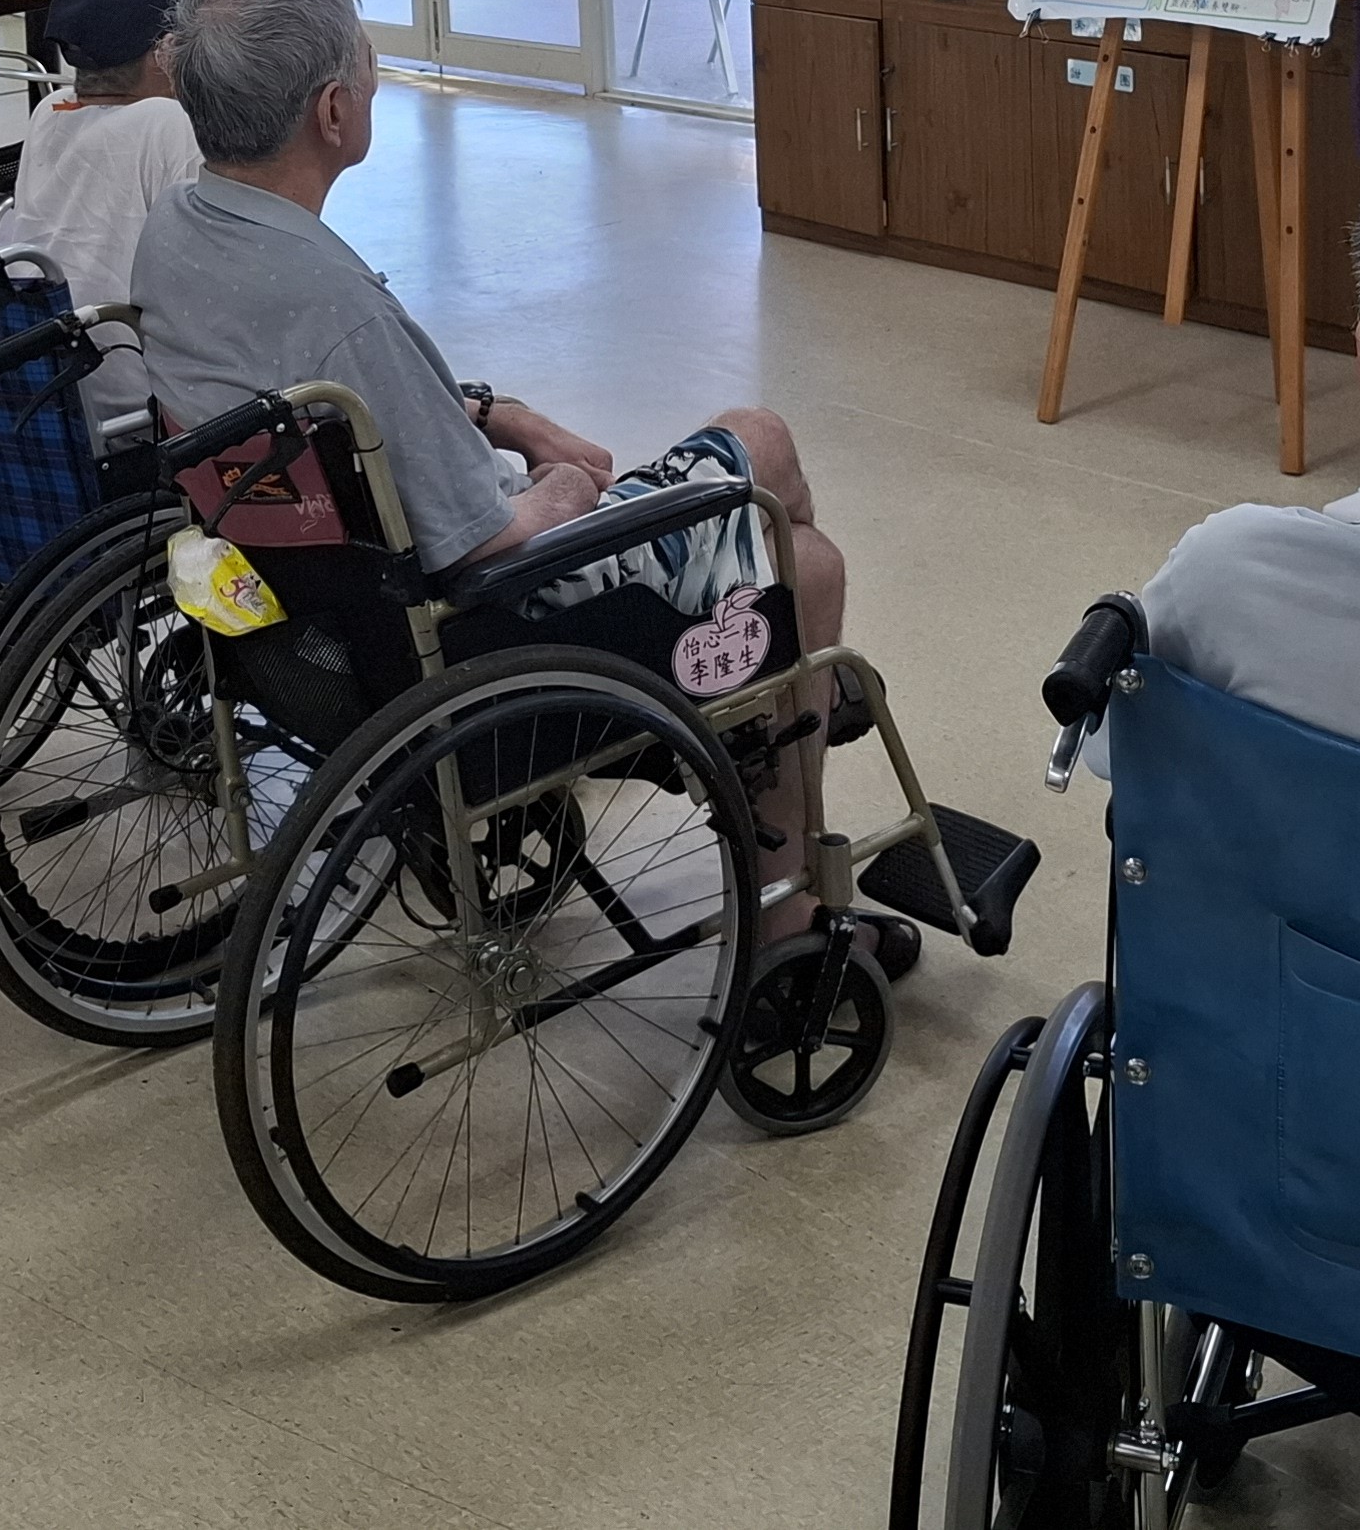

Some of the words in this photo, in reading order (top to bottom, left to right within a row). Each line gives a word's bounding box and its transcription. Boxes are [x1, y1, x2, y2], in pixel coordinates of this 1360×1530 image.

[683, 617, 762, 660] 怡心一樓
[690, 644, 759, 687] 李隆生
